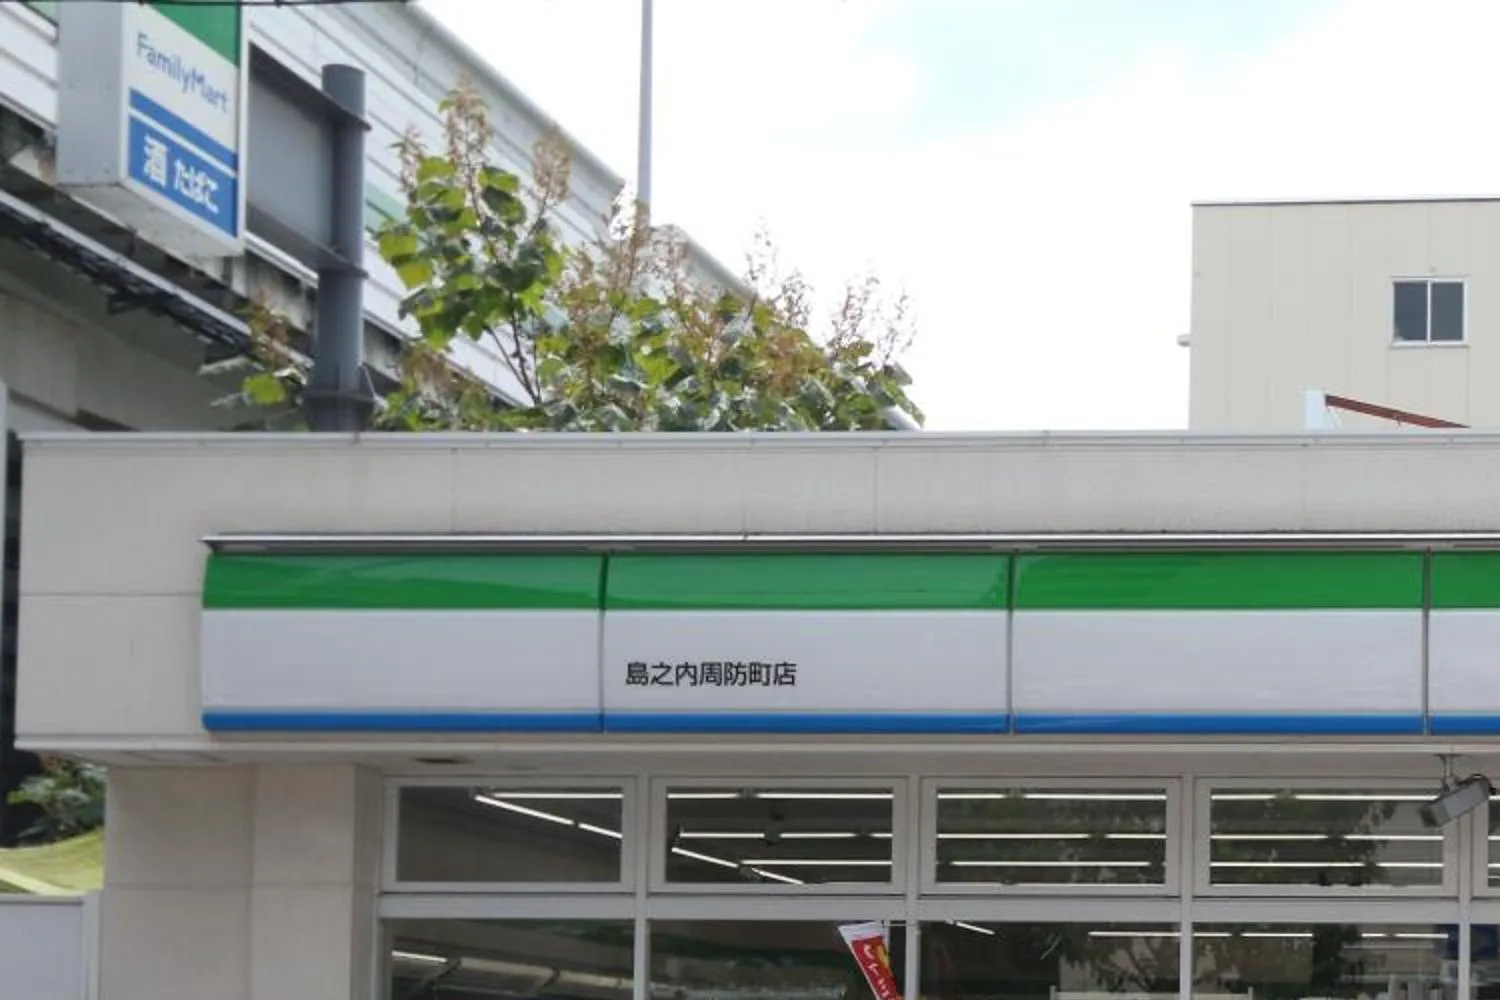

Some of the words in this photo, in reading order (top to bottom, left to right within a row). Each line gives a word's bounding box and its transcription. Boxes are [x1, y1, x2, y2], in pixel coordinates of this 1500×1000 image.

[136, 31, 229, 114] FamilyMart
[625, 661, 798, 687] 島之内周防町店
